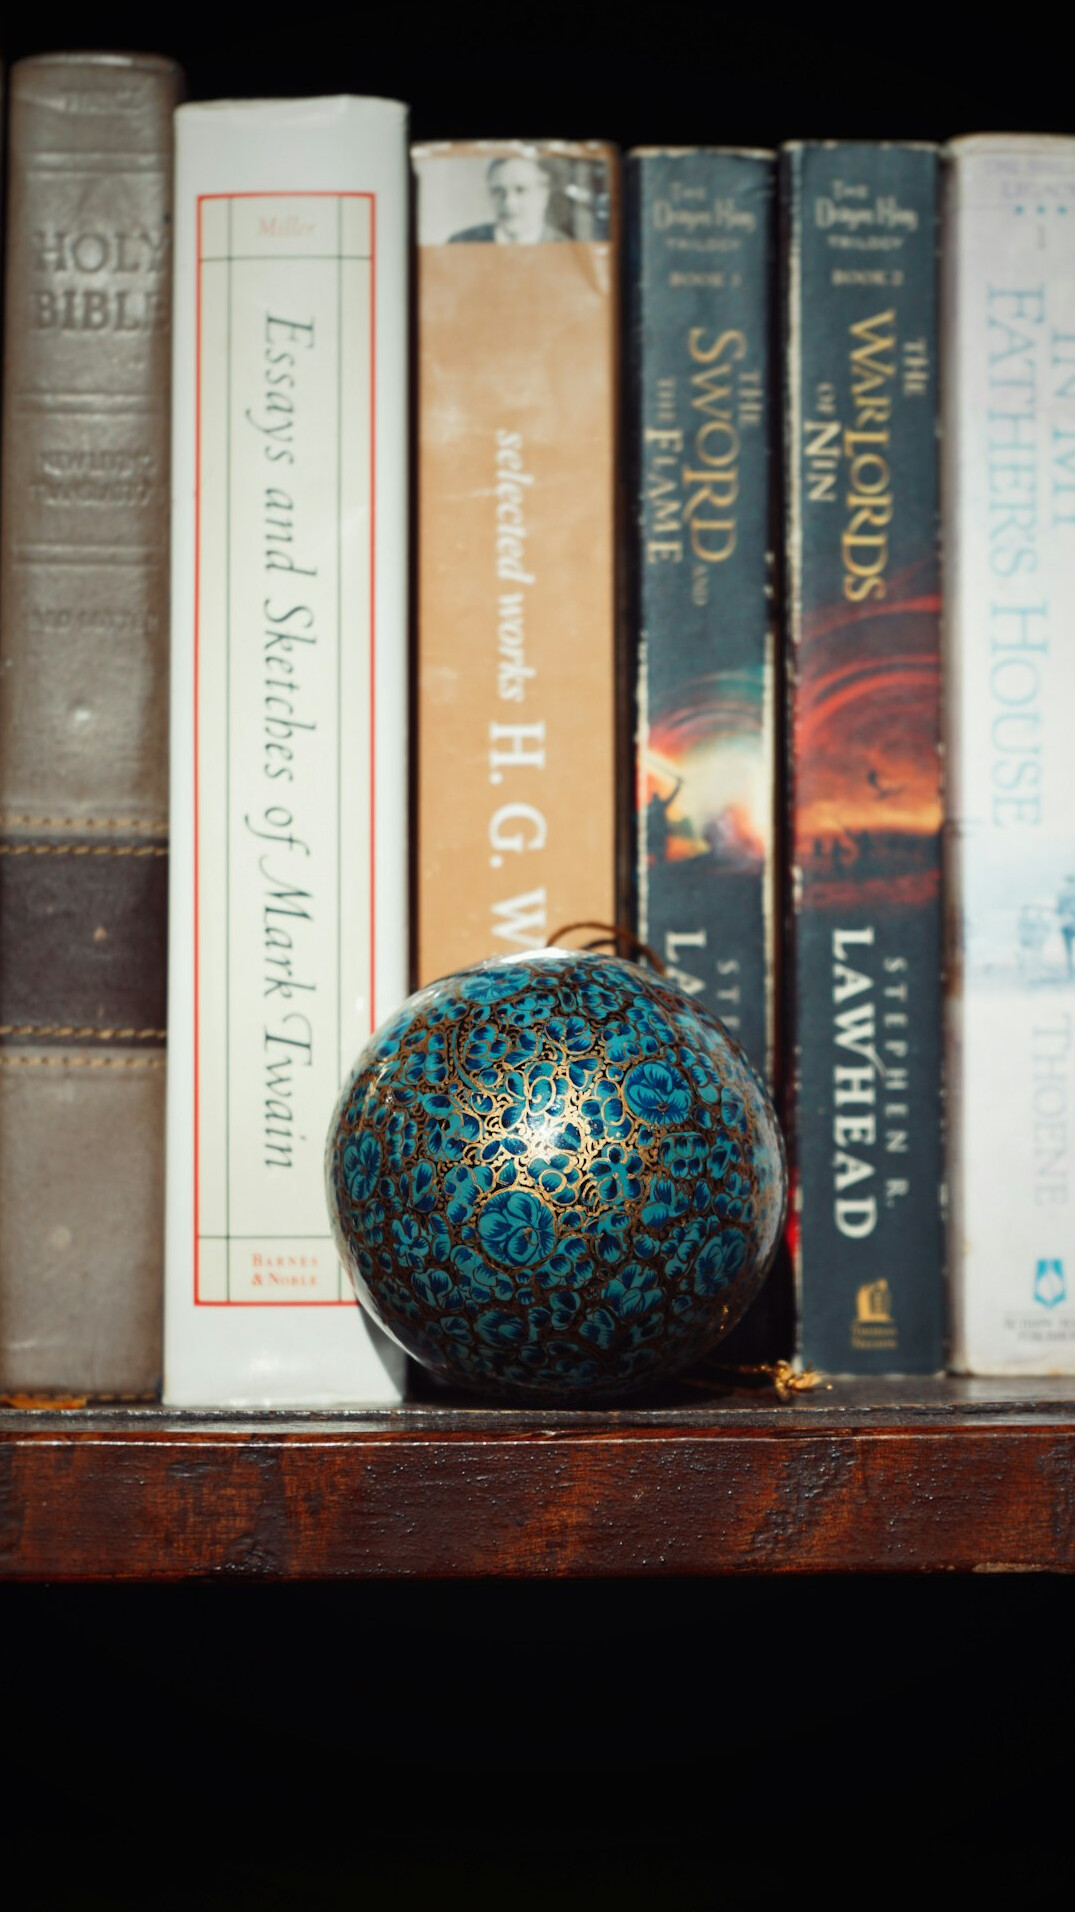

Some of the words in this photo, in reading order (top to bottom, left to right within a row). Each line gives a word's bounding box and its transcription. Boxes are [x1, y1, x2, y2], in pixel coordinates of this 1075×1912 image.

[32, 230, 166, 273] HOLY
[33, 289, 168, 331] BIBLE
[245, 310, 315, 465] Essays
[656, 376, 677, 422] THE
[738, 369, 763, 426] THE
[903, 336, 929, 397] THE
[644, 426, 684, 564] FLAME
[682, 325, 747, 563] SWORD
[803, 418, 842, 502] NIN
[841, 308, 897, 601] WARLORDS
[264, 487, 318, 576] and
[495, 428, 536, 585] selected
[263, 597, 318, 782] Sketches
[497, 592, 537, 703] works
[489, 719, 546, 785] H.
[990, 599, 1049, 828] HOUSE
[244, 805, 311, 857] of
[489, 801, 548, 868] G.
[258, 853, 317, 998] Mark
[263, 1011, 313, 1169] Twain
[832, 926, 878, 1239] LAWHEAD
[883, 957, 909, 1153] STEPHEN
